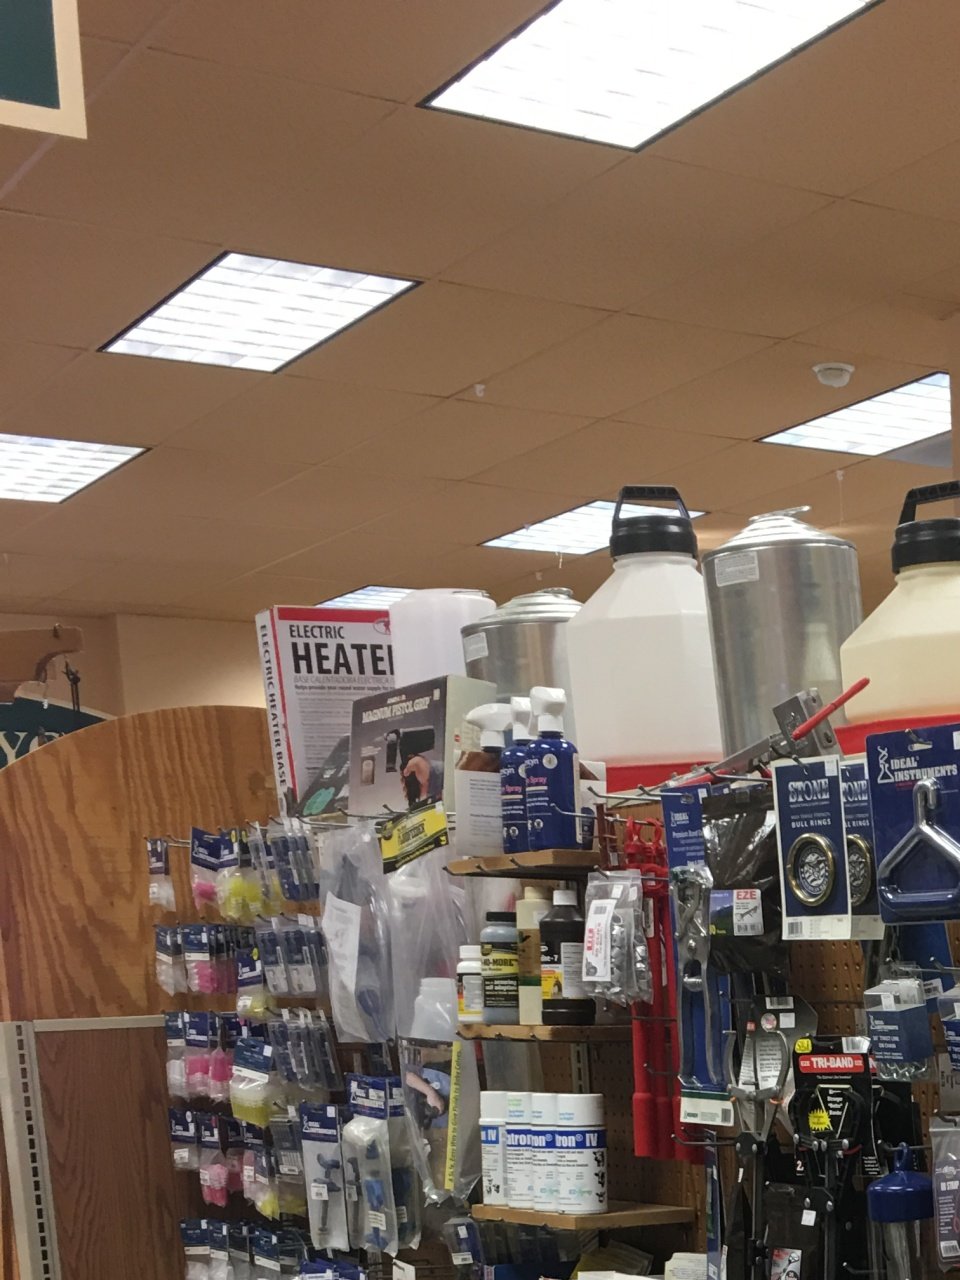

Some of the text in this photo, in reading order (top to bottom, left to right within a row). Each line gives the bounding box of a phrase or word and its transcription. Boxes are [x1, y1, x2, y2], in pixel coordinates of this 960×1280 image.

[289, 624, 345, 640] ELECTRIC
[260, 625, 275, 691] ELECTRIC
[269, 694, 282, 747] HEATER
[362, 707, 392, 724] MAGNUM
[391, 703, 413, 717] PISTOL
[276, 752, 287, 786] BASE
[890, 756, 917, 770] IDEAL
[530, 776, 548, 785] Spray
[893, 764, 958, 783] INSTRUMENTS
[788, 778, 830, 803] STONE
[791, 817, 831, 829] BULL RINGS
[736, 890, 757, 900] EZE
[811, 1057, 854, 1069] TRI-BAND
[488, 1130, 497, 1141] IV
[586, 1133, 598, 1147] IV
